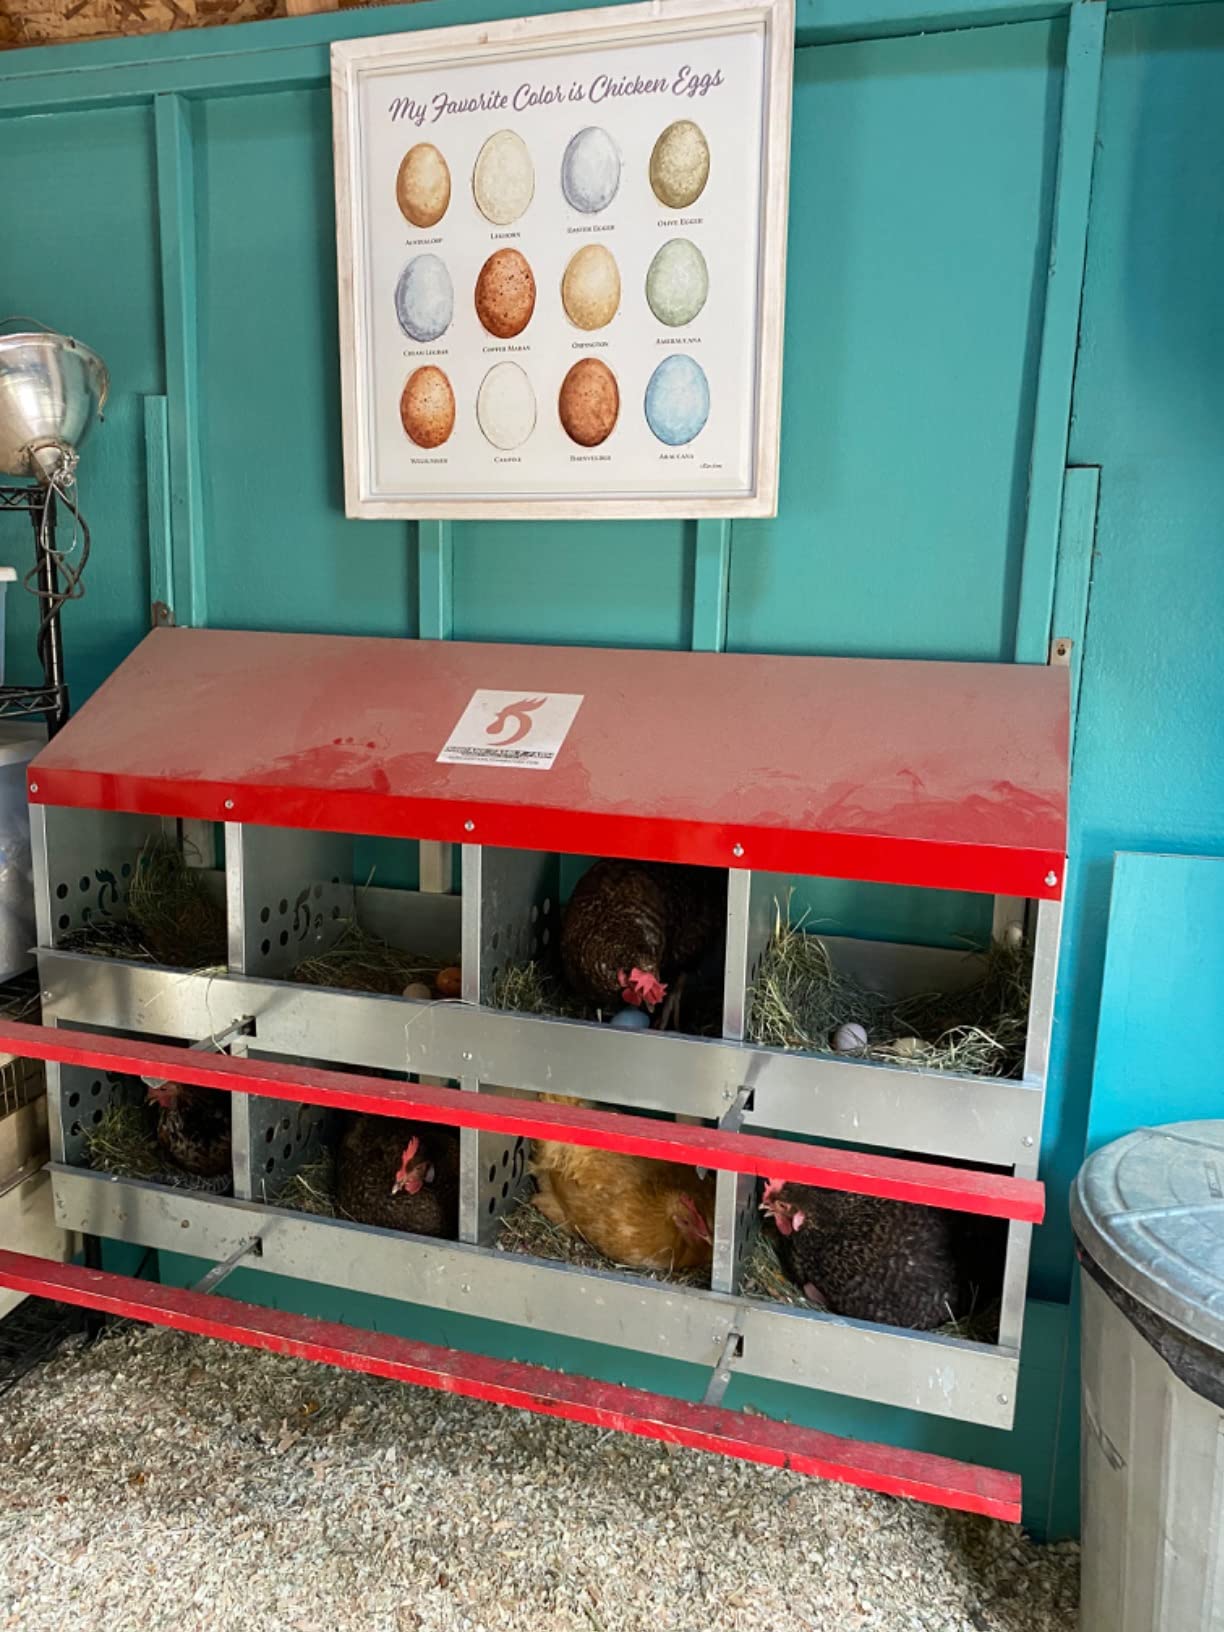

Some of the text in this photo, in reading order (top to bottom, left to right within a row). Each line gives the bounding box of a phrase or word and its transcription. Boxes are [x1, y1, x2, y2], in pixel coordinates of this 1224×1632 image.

[388, 64, 725, 127] My Favorite Color is Chicken Eggs
